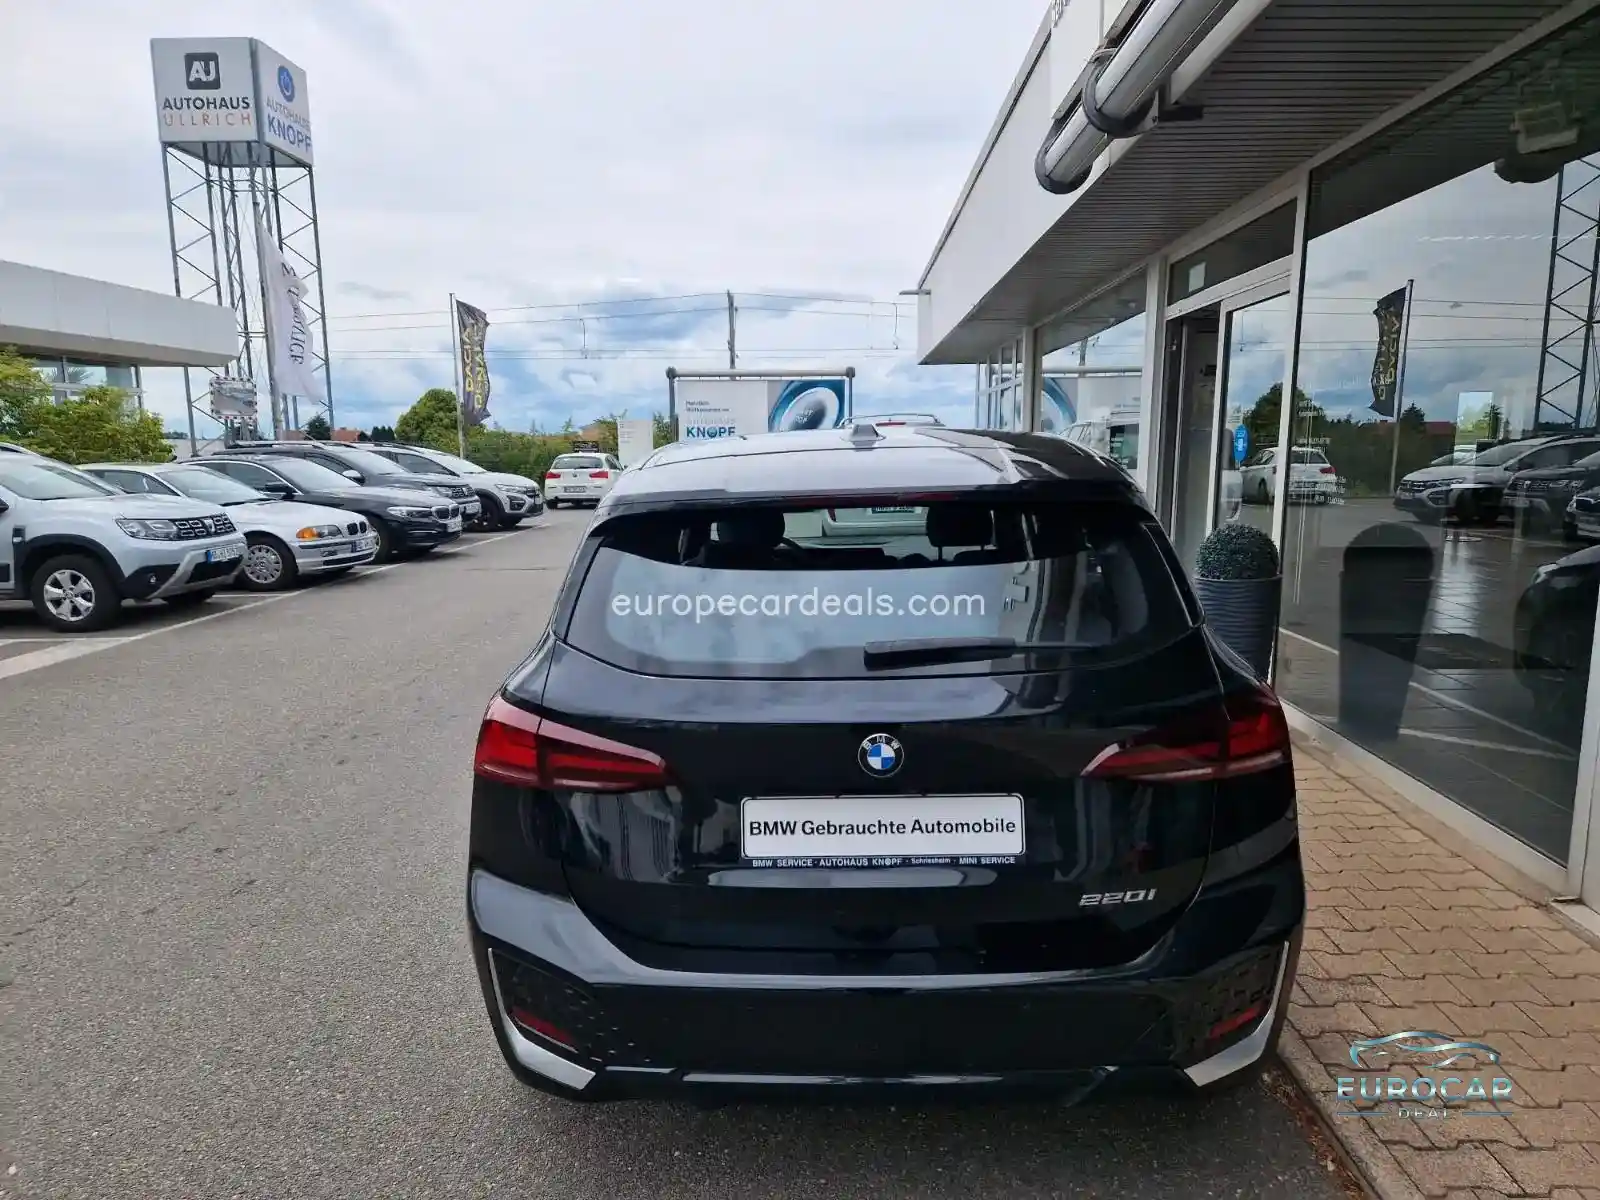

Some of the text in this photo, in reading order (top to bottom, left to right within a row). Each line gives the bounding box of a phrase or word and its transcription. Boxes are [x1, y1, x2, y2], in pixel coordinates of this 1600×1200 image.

[162, 96, 250, 110] AUTOHAUS
[164, 112, 252, 126] ULLRICH
[267, 113, 312, 153] KNOPF
[686, 426, 736, 438] KNOPF
[861, 735, 901, 750] BMW
[749, 818, 1017, 836] BMW Gebrauchte Automobile
[752, 859, 773, 868] BMW
[777, 858, 814, 867] SERVICE
[819, 858, 869, 867] AUTOHAUS
[872, 857, 902, 866] KNOPF
[959, 857, 978, 865] MINI
[981, 856, 1016, 865] SERVICE
